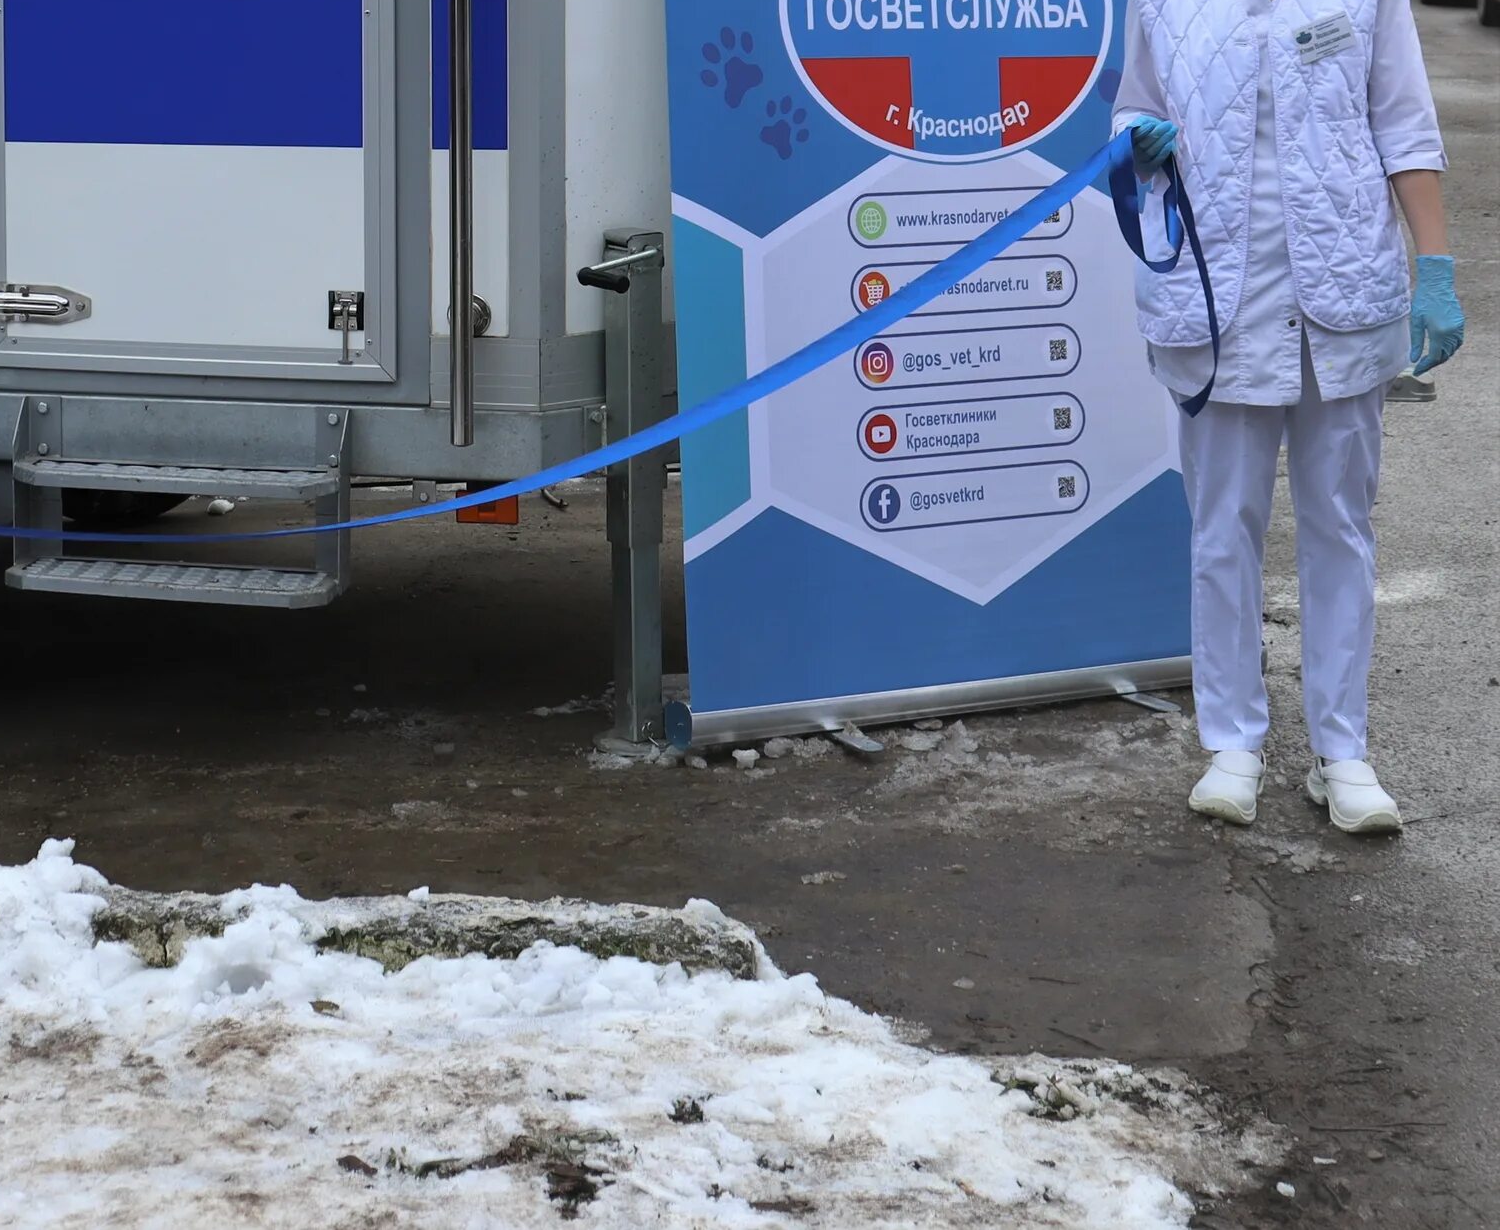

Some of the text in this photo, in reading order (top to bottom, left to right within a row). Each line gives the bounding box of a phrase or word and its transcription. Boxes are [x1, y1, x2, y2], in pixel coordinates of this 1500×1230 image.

[884, 100, 1032, 141] г. Краснодар
[896, 208, 1009, 226] www.krasnodarvet
[902, 344, 1001, 373] @gos_vet_krd
[905, 409, 997, 428] Госветклиники
[906, 432, 980, 453] Краснодара
[909, 485, 985, 511] @gosvetkrd
